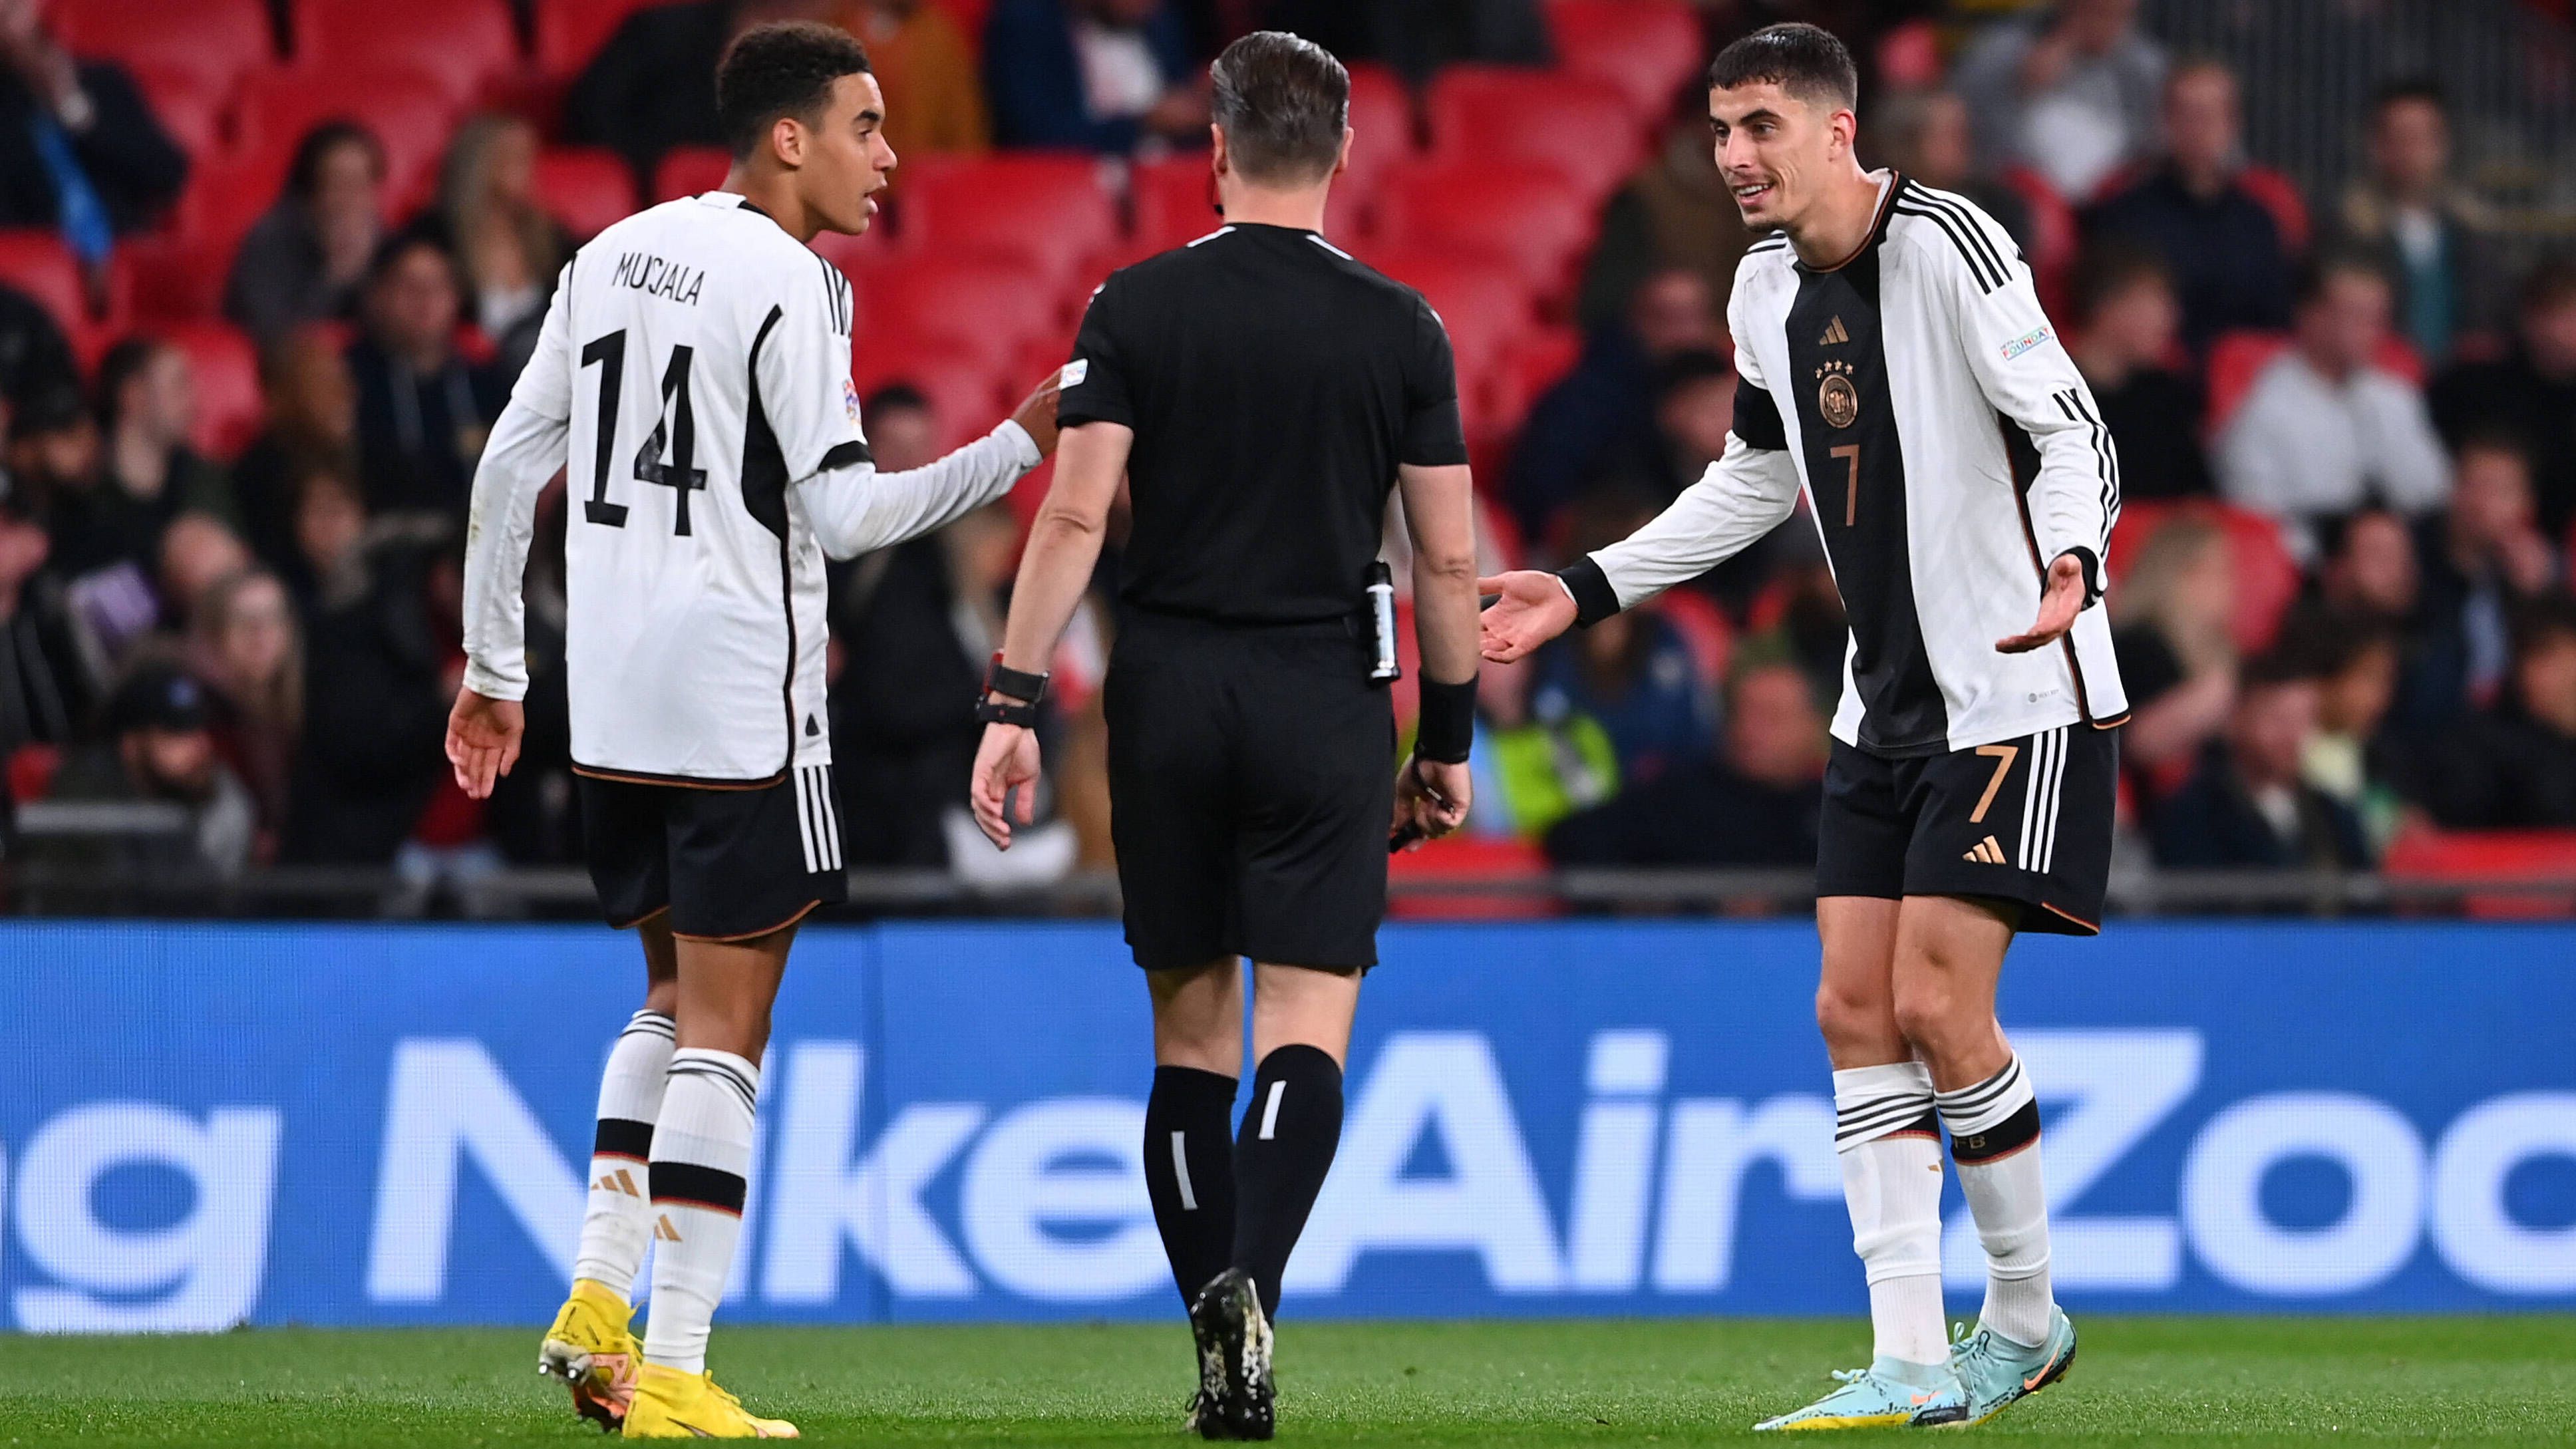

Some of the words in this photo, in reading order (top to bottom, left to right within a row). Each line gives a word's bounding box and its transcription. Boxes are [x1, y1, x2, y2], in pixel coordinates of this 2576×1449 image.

[581, 328, 707, 537] 14
[1830, 444, 1860, 527] 7
[1968, 745, 2019, 823] 7
[1278, 1027, 1845, 1297] Air
